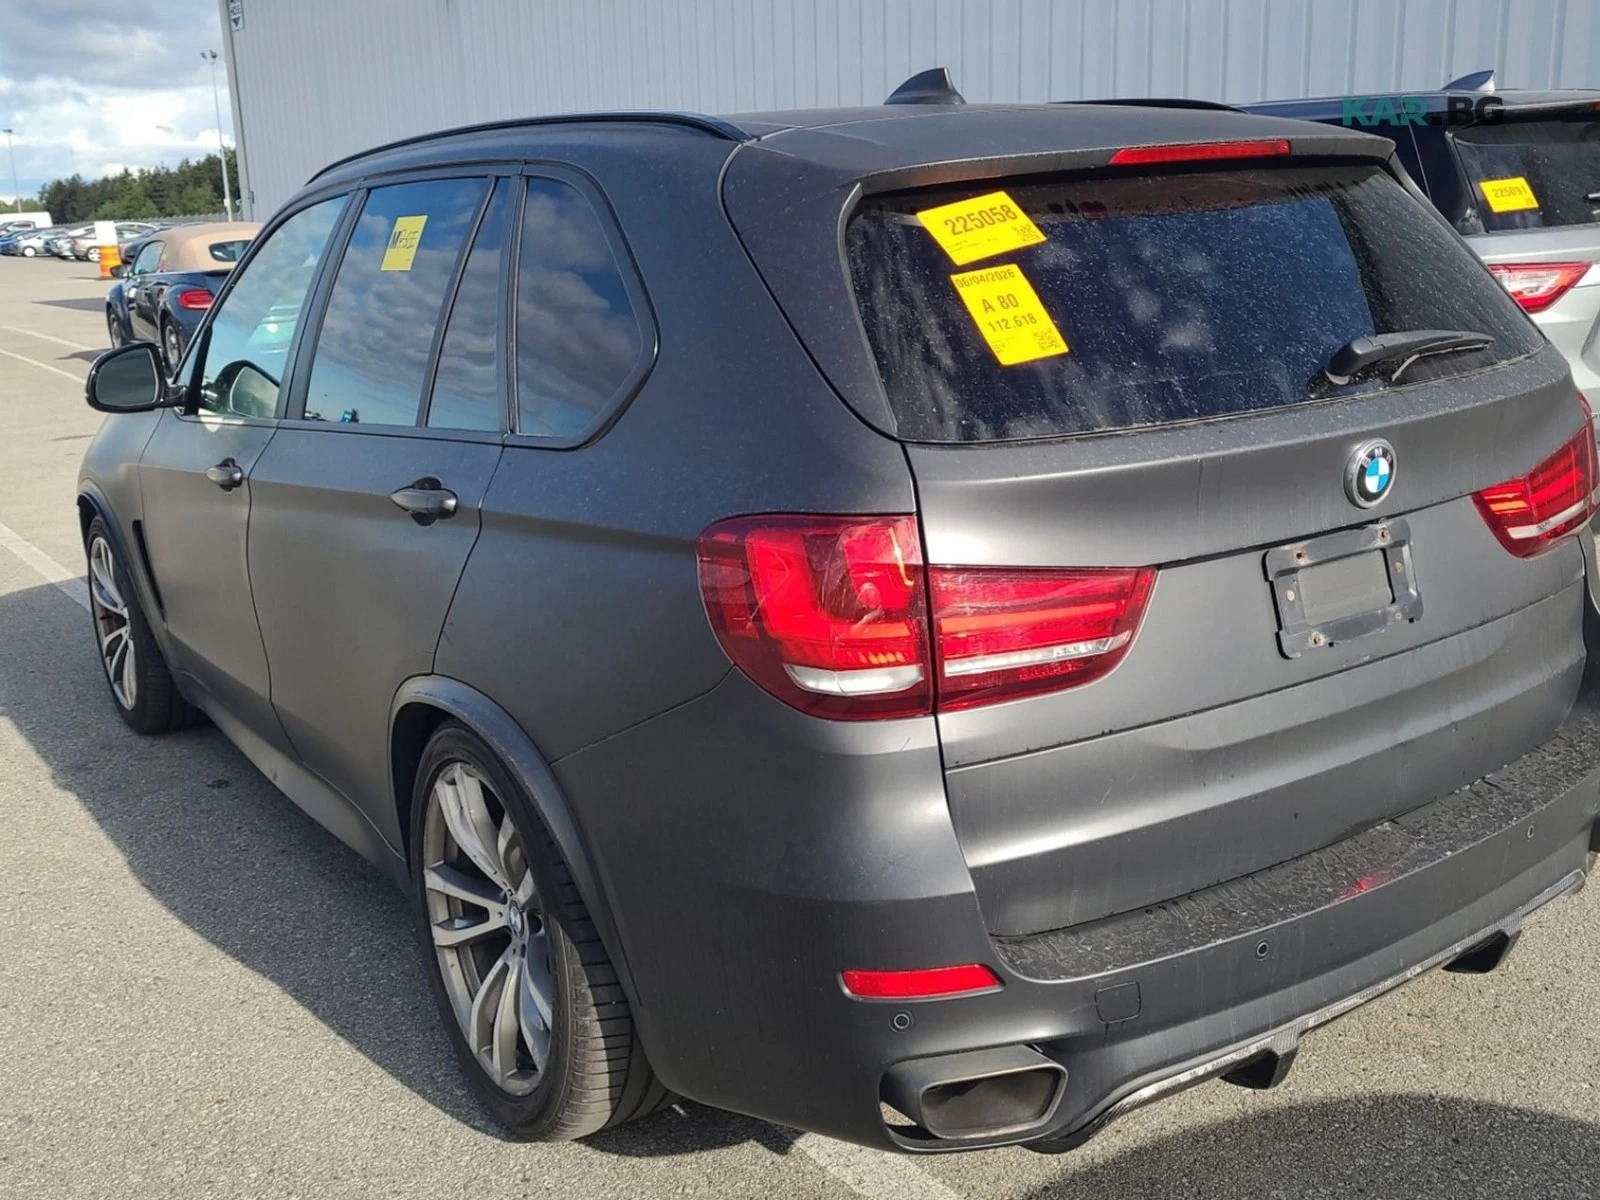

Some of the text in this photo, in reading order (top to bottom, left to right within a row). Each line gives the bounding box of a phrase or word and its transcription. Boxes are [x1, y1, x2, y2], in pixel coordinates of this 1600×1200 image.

[944, 204, 1018, 236] 225058
[955, 268, 1016, 289] 06/04/2026
[981, 293, 1020, 313] A 80
[1361, 447, 1393, 468] BMW
